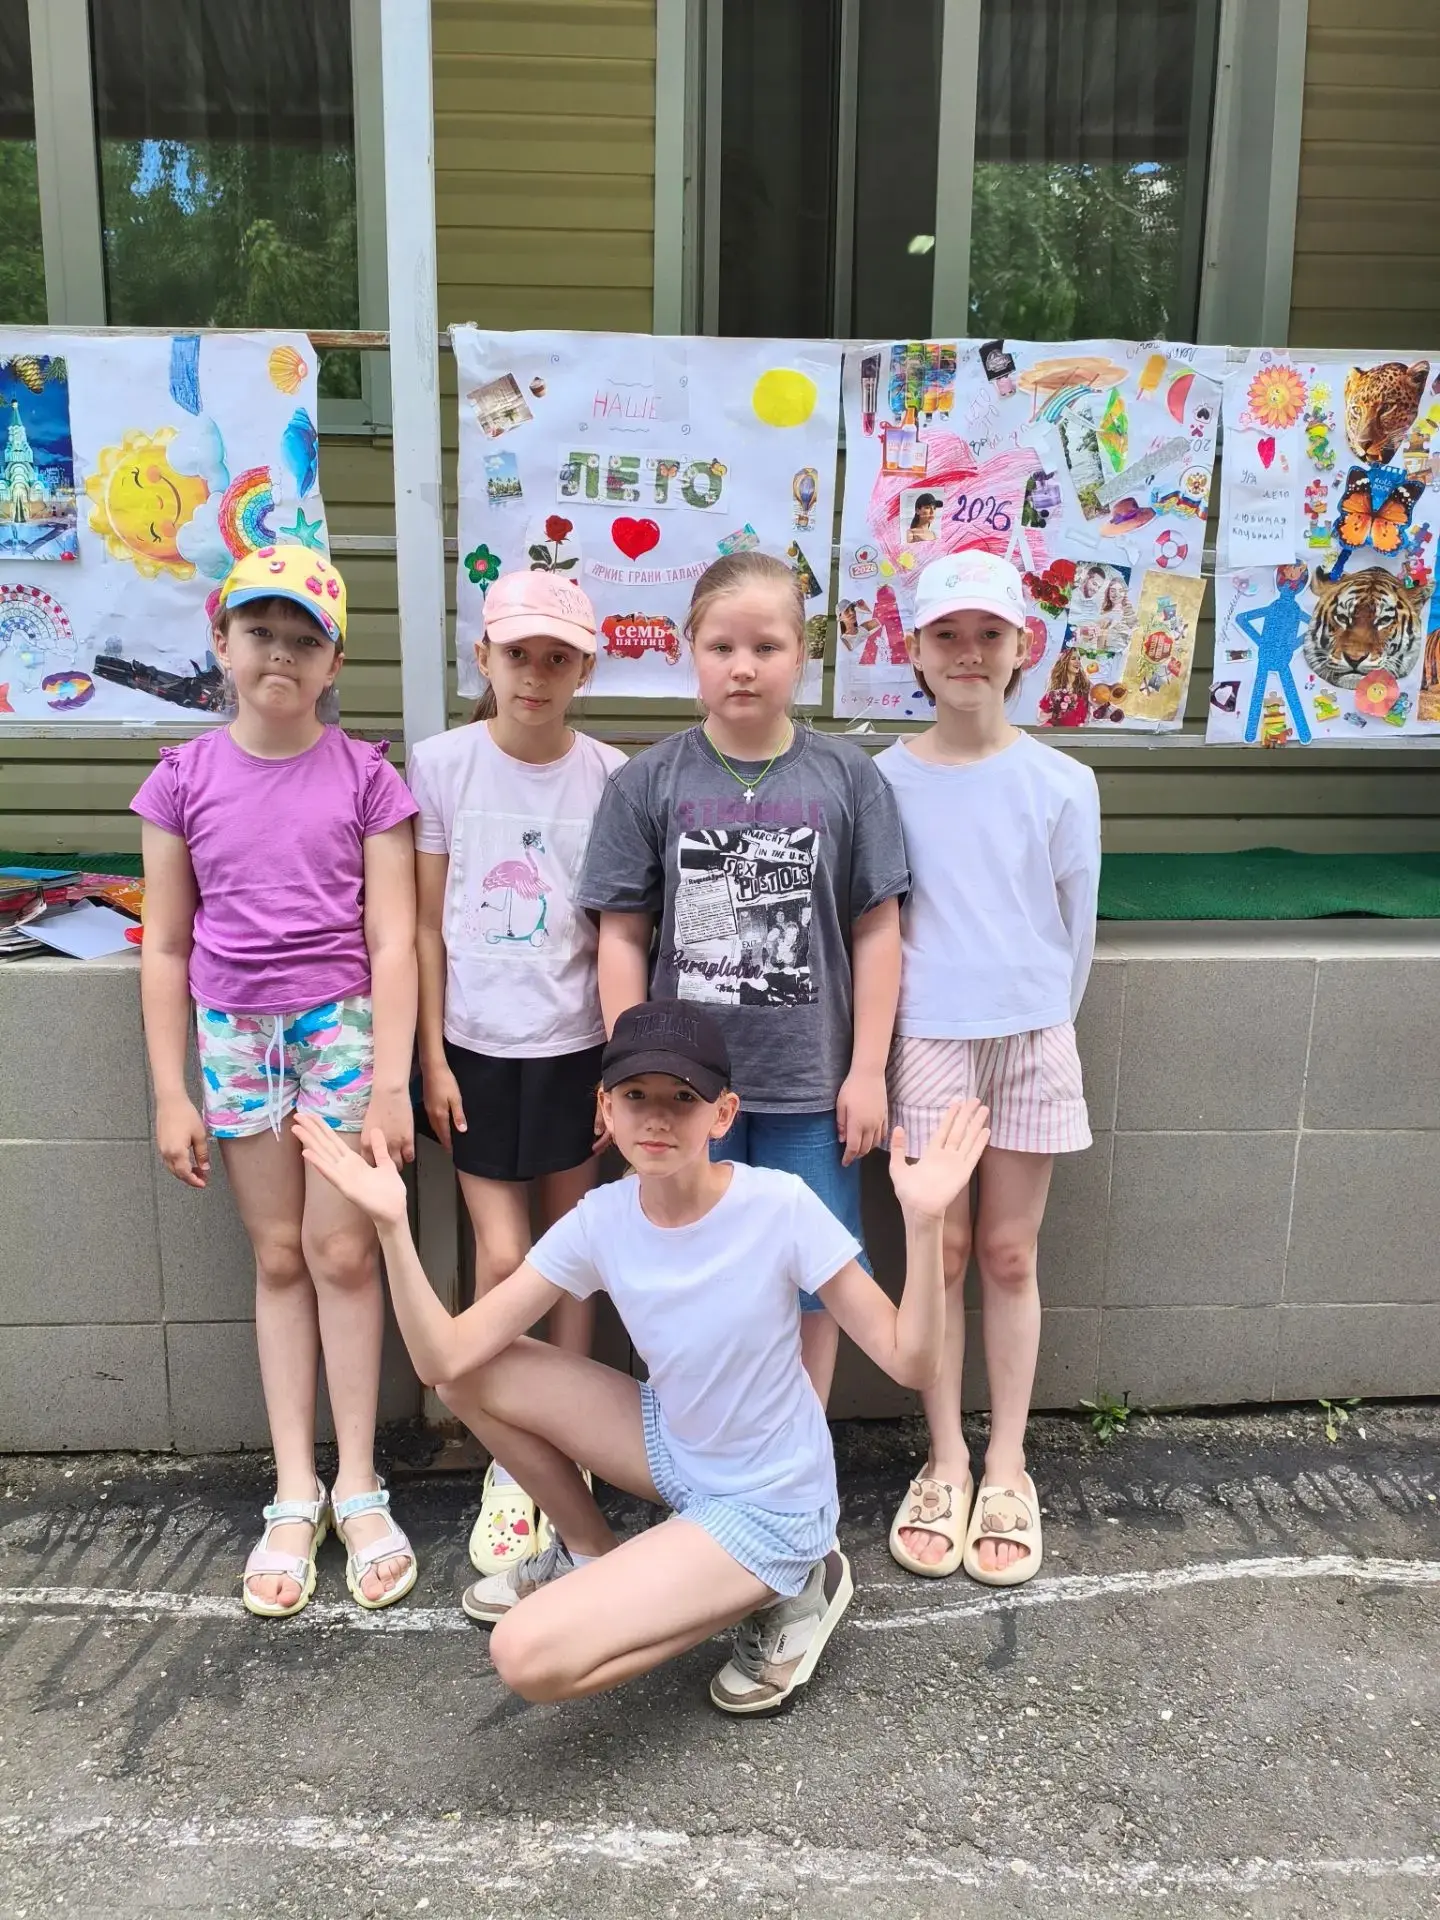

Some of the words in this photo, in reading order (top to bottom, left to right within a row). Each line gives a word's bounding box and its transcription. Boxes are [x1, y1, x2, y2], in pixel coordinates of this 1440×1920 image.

[593, 390, 664, 422] НАШЕ
[559, 451, 728, 508] ЛЕТО
[952, 494, 1012, 532] 2026
[592, 563, 624, 583] ЯРКИЕ
[628, 571, 661, 583] ГРАНИ
[853, 566, 876, 576] 2026
[742, 830, 785, 845] ANARCHY
[758, 849, 768, 857] IN
[771, 850, 786, 859] THE
[736, 865, 810, 900] PISTOLS
